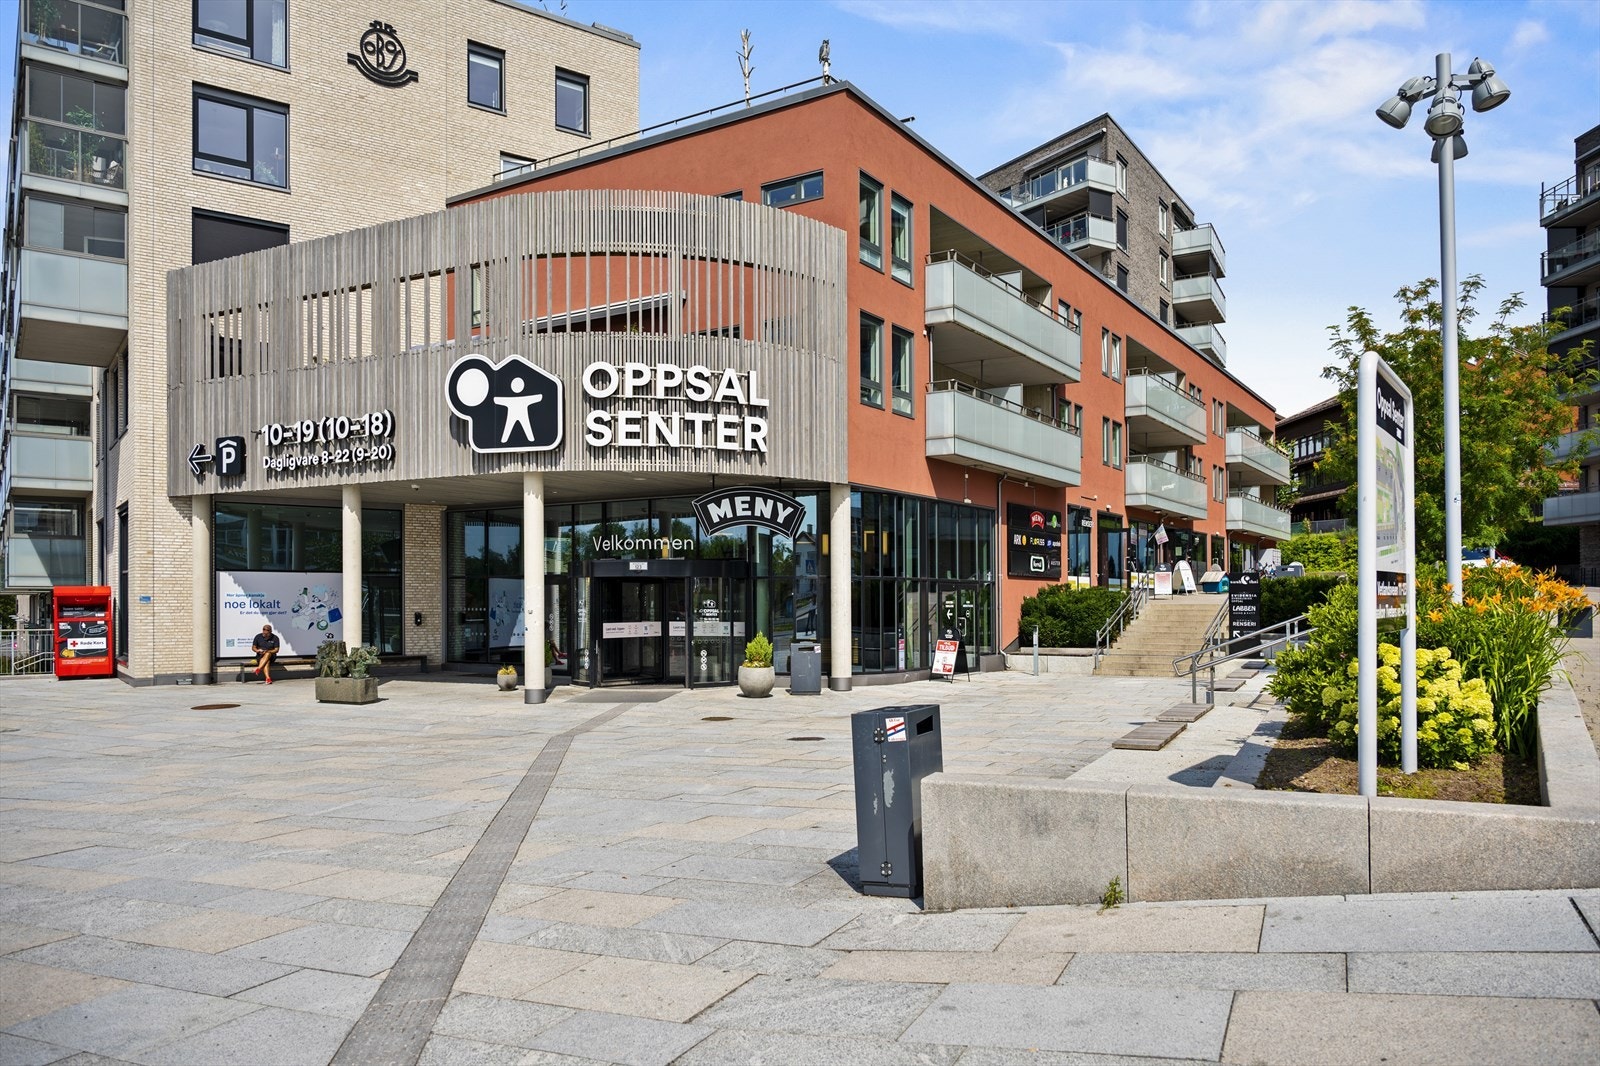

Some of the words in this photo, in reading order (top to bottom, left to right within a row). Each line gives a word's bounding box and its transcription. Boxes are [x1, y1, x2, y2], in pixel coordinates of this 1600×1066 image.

[582, 361, 769, 407] OPPSAL
[261, 419, 315, 446] 10-19
[319, 409, 392, 443] (10-18)
[585, 409, 769, 452] SENTER
[221, 447, 237, 474] P
[263, 453, 319, 471] Dagligvare
[706, 496, 794, 524] MENY
[1032, 514, 1044, 523] MENY
[592, 534, 694, 551] Velkommen
[1014, 534, 1022, 545] ARK
[224, 601, 246, 609] noe
[249, 599, 281, 609] lokalt
